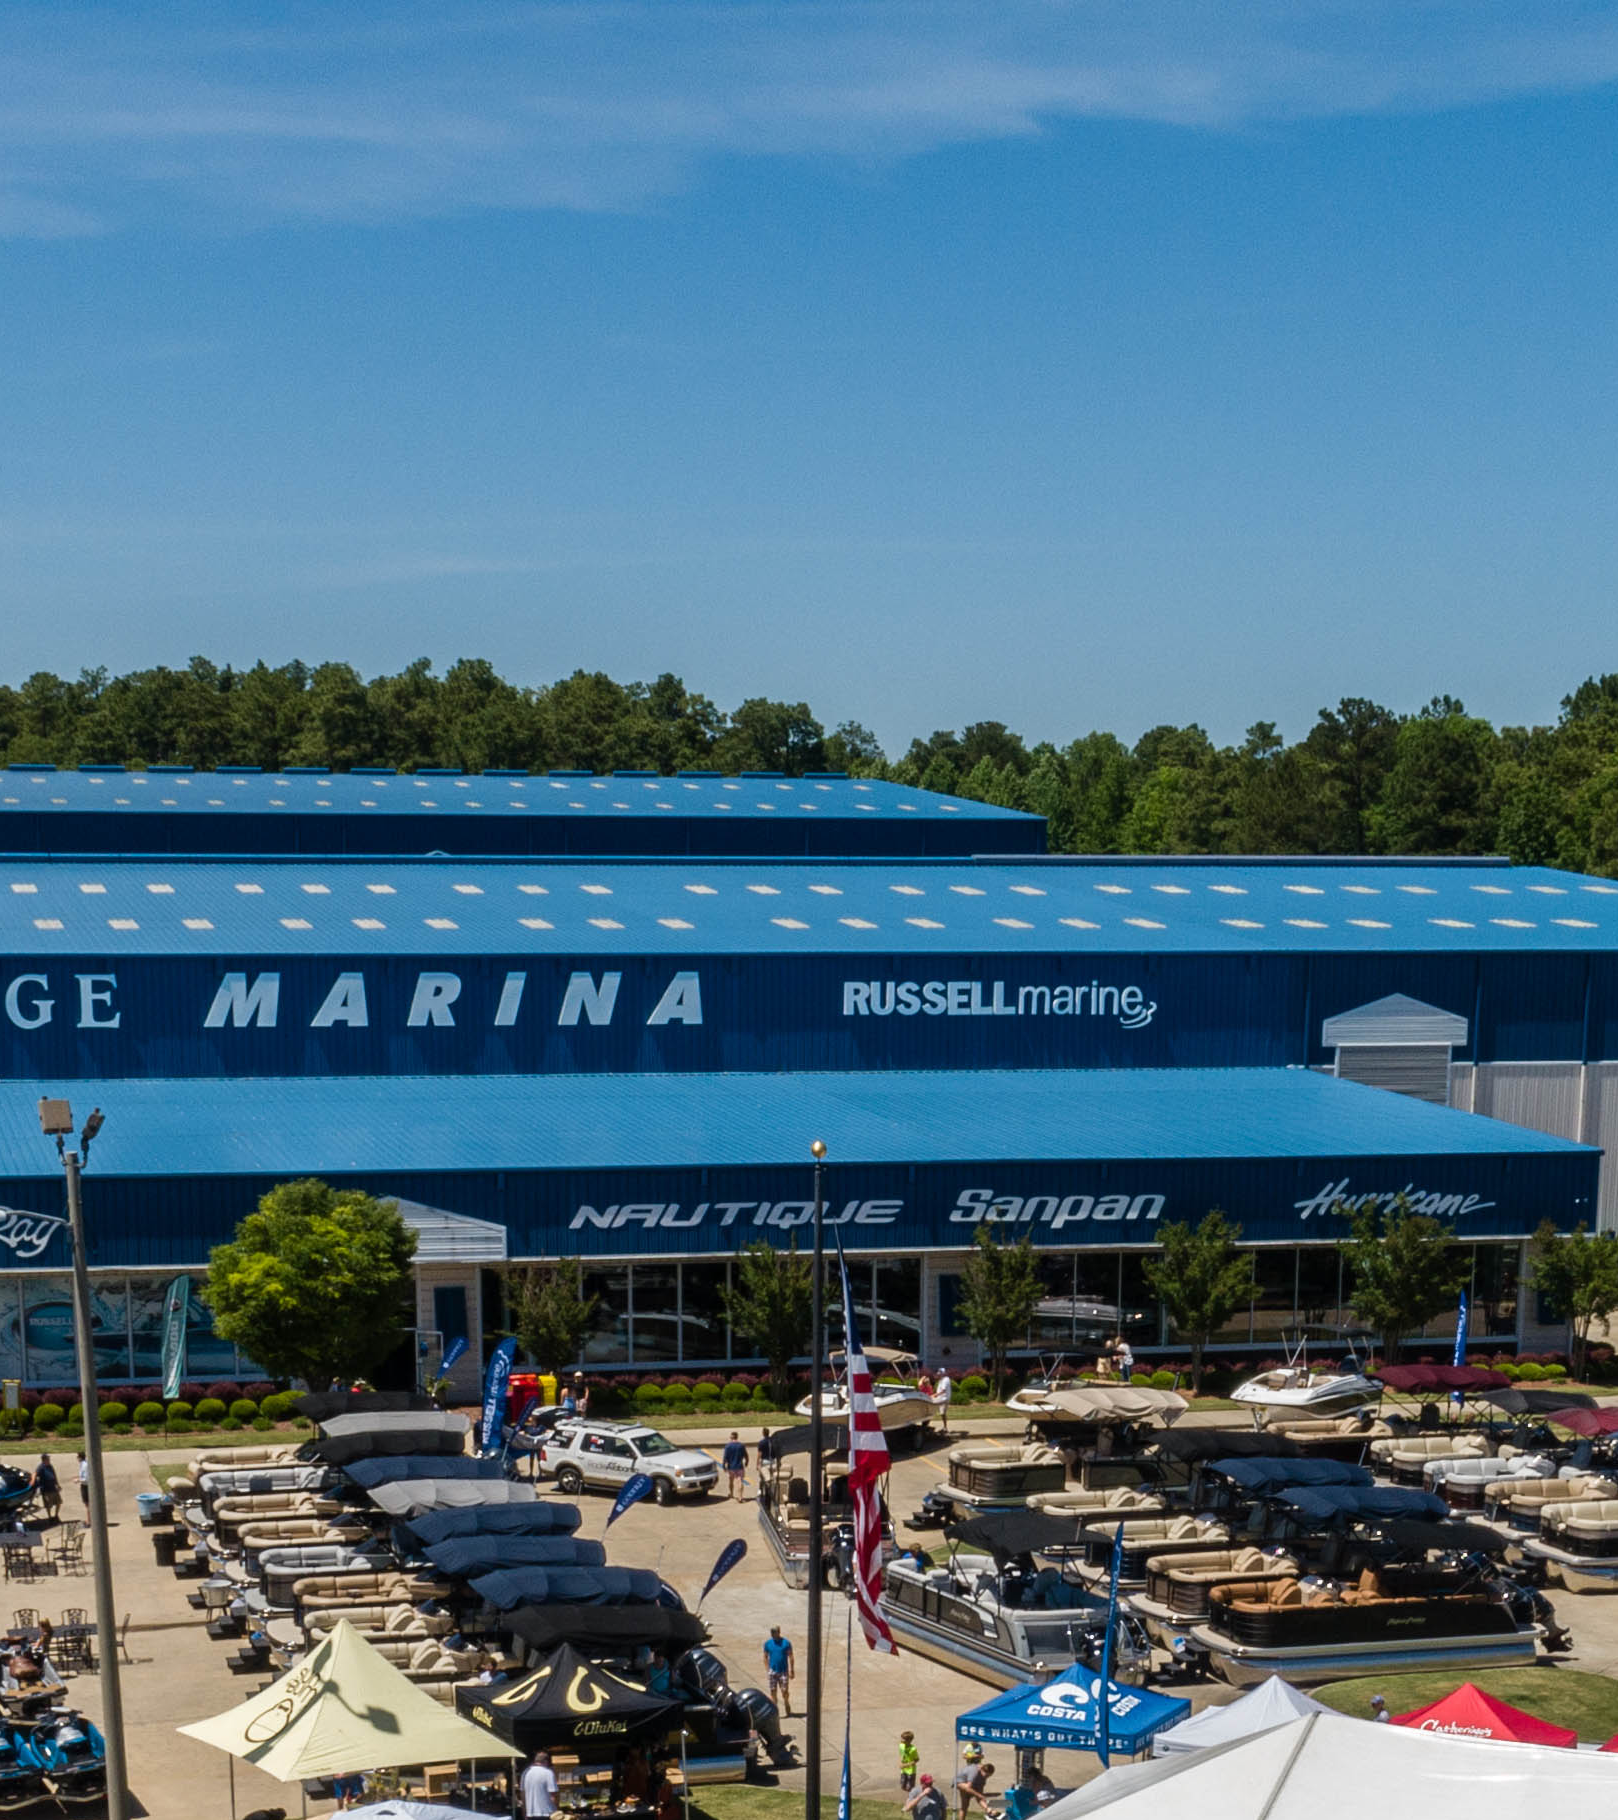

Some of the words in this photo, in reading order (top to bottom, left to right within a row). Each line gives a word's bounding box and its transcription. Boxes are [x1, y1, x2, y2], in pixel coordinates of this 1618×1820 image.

[203, 970, 705, 1029] MARINA
[842, 980, 1144, 1018] RUSSELLmarine
[568, 1199, 906, 1230] NAUTIQUE
[949, 1187, 1166, 1229] Sanpan
[1293, 1176, 1497, 1220] Hurricane
[1027, 1704, 1087, 1721] COSTA
[960, 1726, 986, 1737] SEE
[991, 1728, 1042, 1741] WHAT'S
